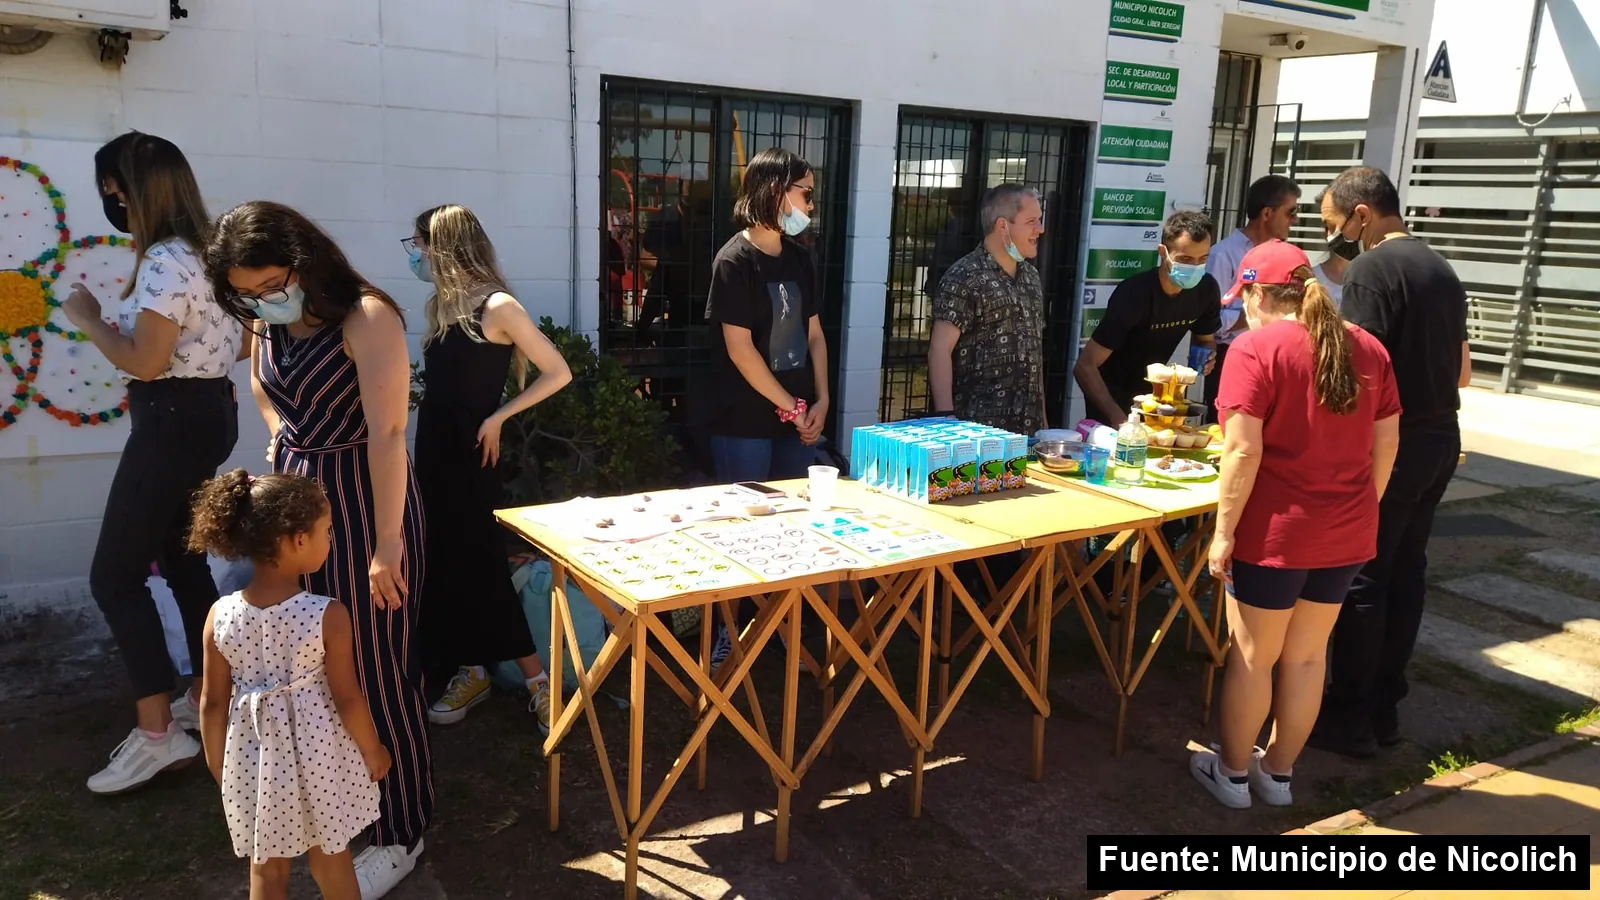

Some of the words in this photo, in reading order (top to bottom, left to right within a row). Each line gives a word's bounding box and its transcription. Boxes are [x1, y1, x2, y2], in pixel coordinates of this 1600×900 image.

[1114, 1, 1147, 13] MUNICIPIO
[1148, 5, 1177, 17] NICOLICH
[1112, 15, 1131, 24] CIUDAD
[1132, 17, 1146, 26] GRAL.
[1147, 18, 1161, 28] LÍBER
[1107, 65, 1121, 75] SEC.
[1123, 67, 1132, 76] DE
[1132, 68, 1171, 80] DESARROLLO
[1106, 79, 1126, 88] LOCAL
[1133, 81, 1176, 93] PARTICIPACIÓN
[1101, 136, 1134, 147] ATENCIÓN
[1135, 138, 1169, 149] CIUDADANA
[1102, 192, 1125, 202] BANCO
[1125, 193, 1134, 202] DE
[1101, 204, 1134, 214] PREVISIÓN
[1135, 206, 1156, 216] SOCIAL
[1143, 230, 1158, 240] BPS
[1105, 258, 1142, 269] POLICLÍNICA
[1086, 318, 1101, 328] PRO
